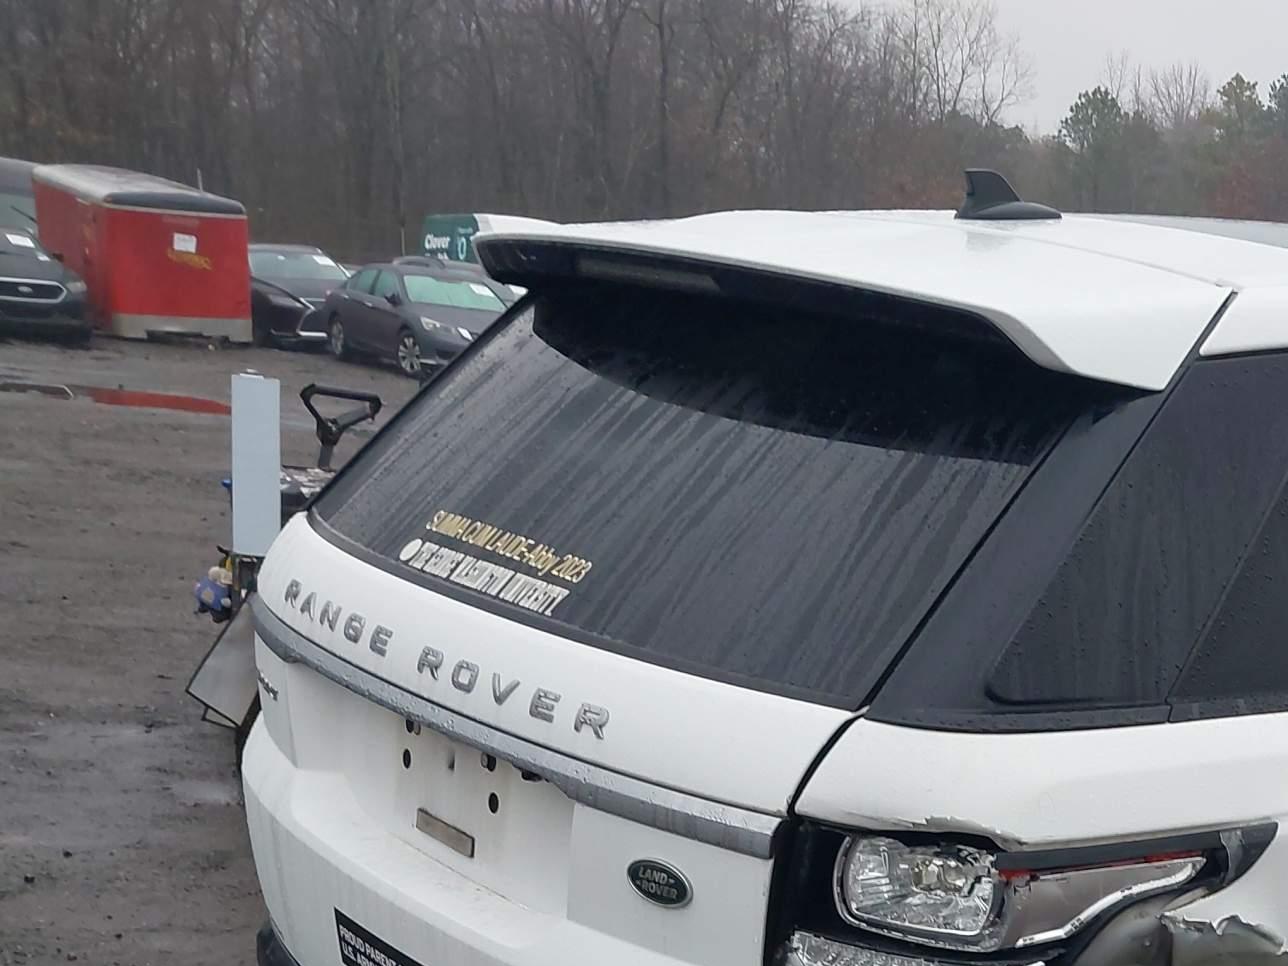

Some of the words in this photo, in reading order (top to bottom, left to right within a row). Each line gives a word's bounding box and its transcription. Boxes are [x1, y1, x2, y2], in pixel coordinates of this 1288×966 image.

[551, 554, 592, 583] 2023
[284, 579, 394, 657] RANGE
[416, 645, 611, 740] ROVER
[638, 866, 668, 885] LAND
[641, 880, 678, 900] ROVER
[338, 924, 366, 953] PROUD
